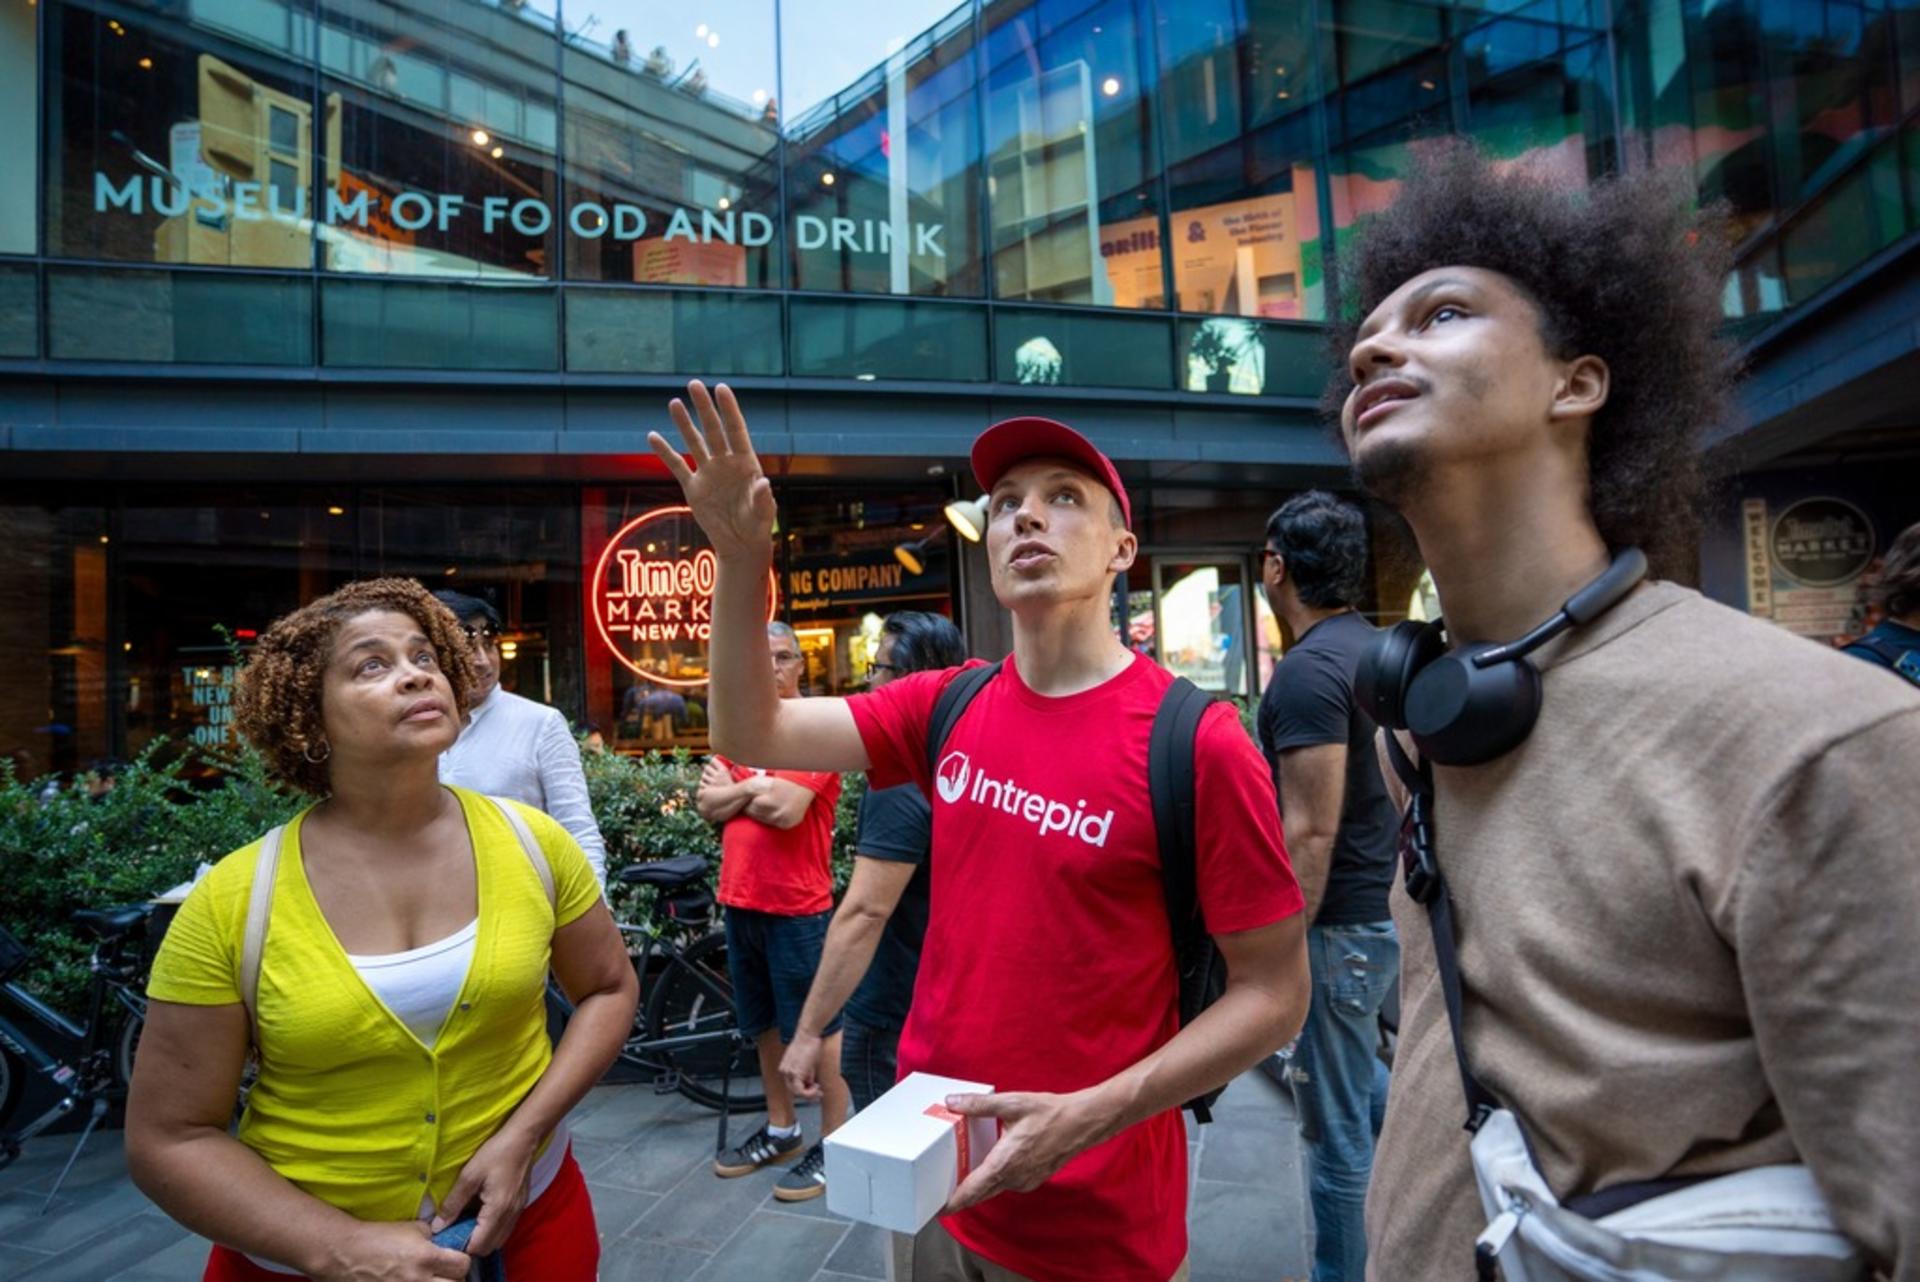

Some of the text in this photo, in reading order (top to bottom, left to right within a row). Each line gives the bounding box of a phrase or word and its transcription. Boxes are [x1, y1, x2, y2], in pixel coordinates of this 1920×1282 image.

[94, 172, 946, 258] MUSEUM OF FOOD AND DRINK
[617, 549, 717, 597] TimeO
[790, 563, 902, 594] NG COMPANY
[607, 600, 710, 622] MARK
[632, 623, 711, 642] NEW YO
[192, 686, 230, 705] NEW
[195, 726, 230, 746] ONE
[970, 768, 1115, 848] Intrepid
